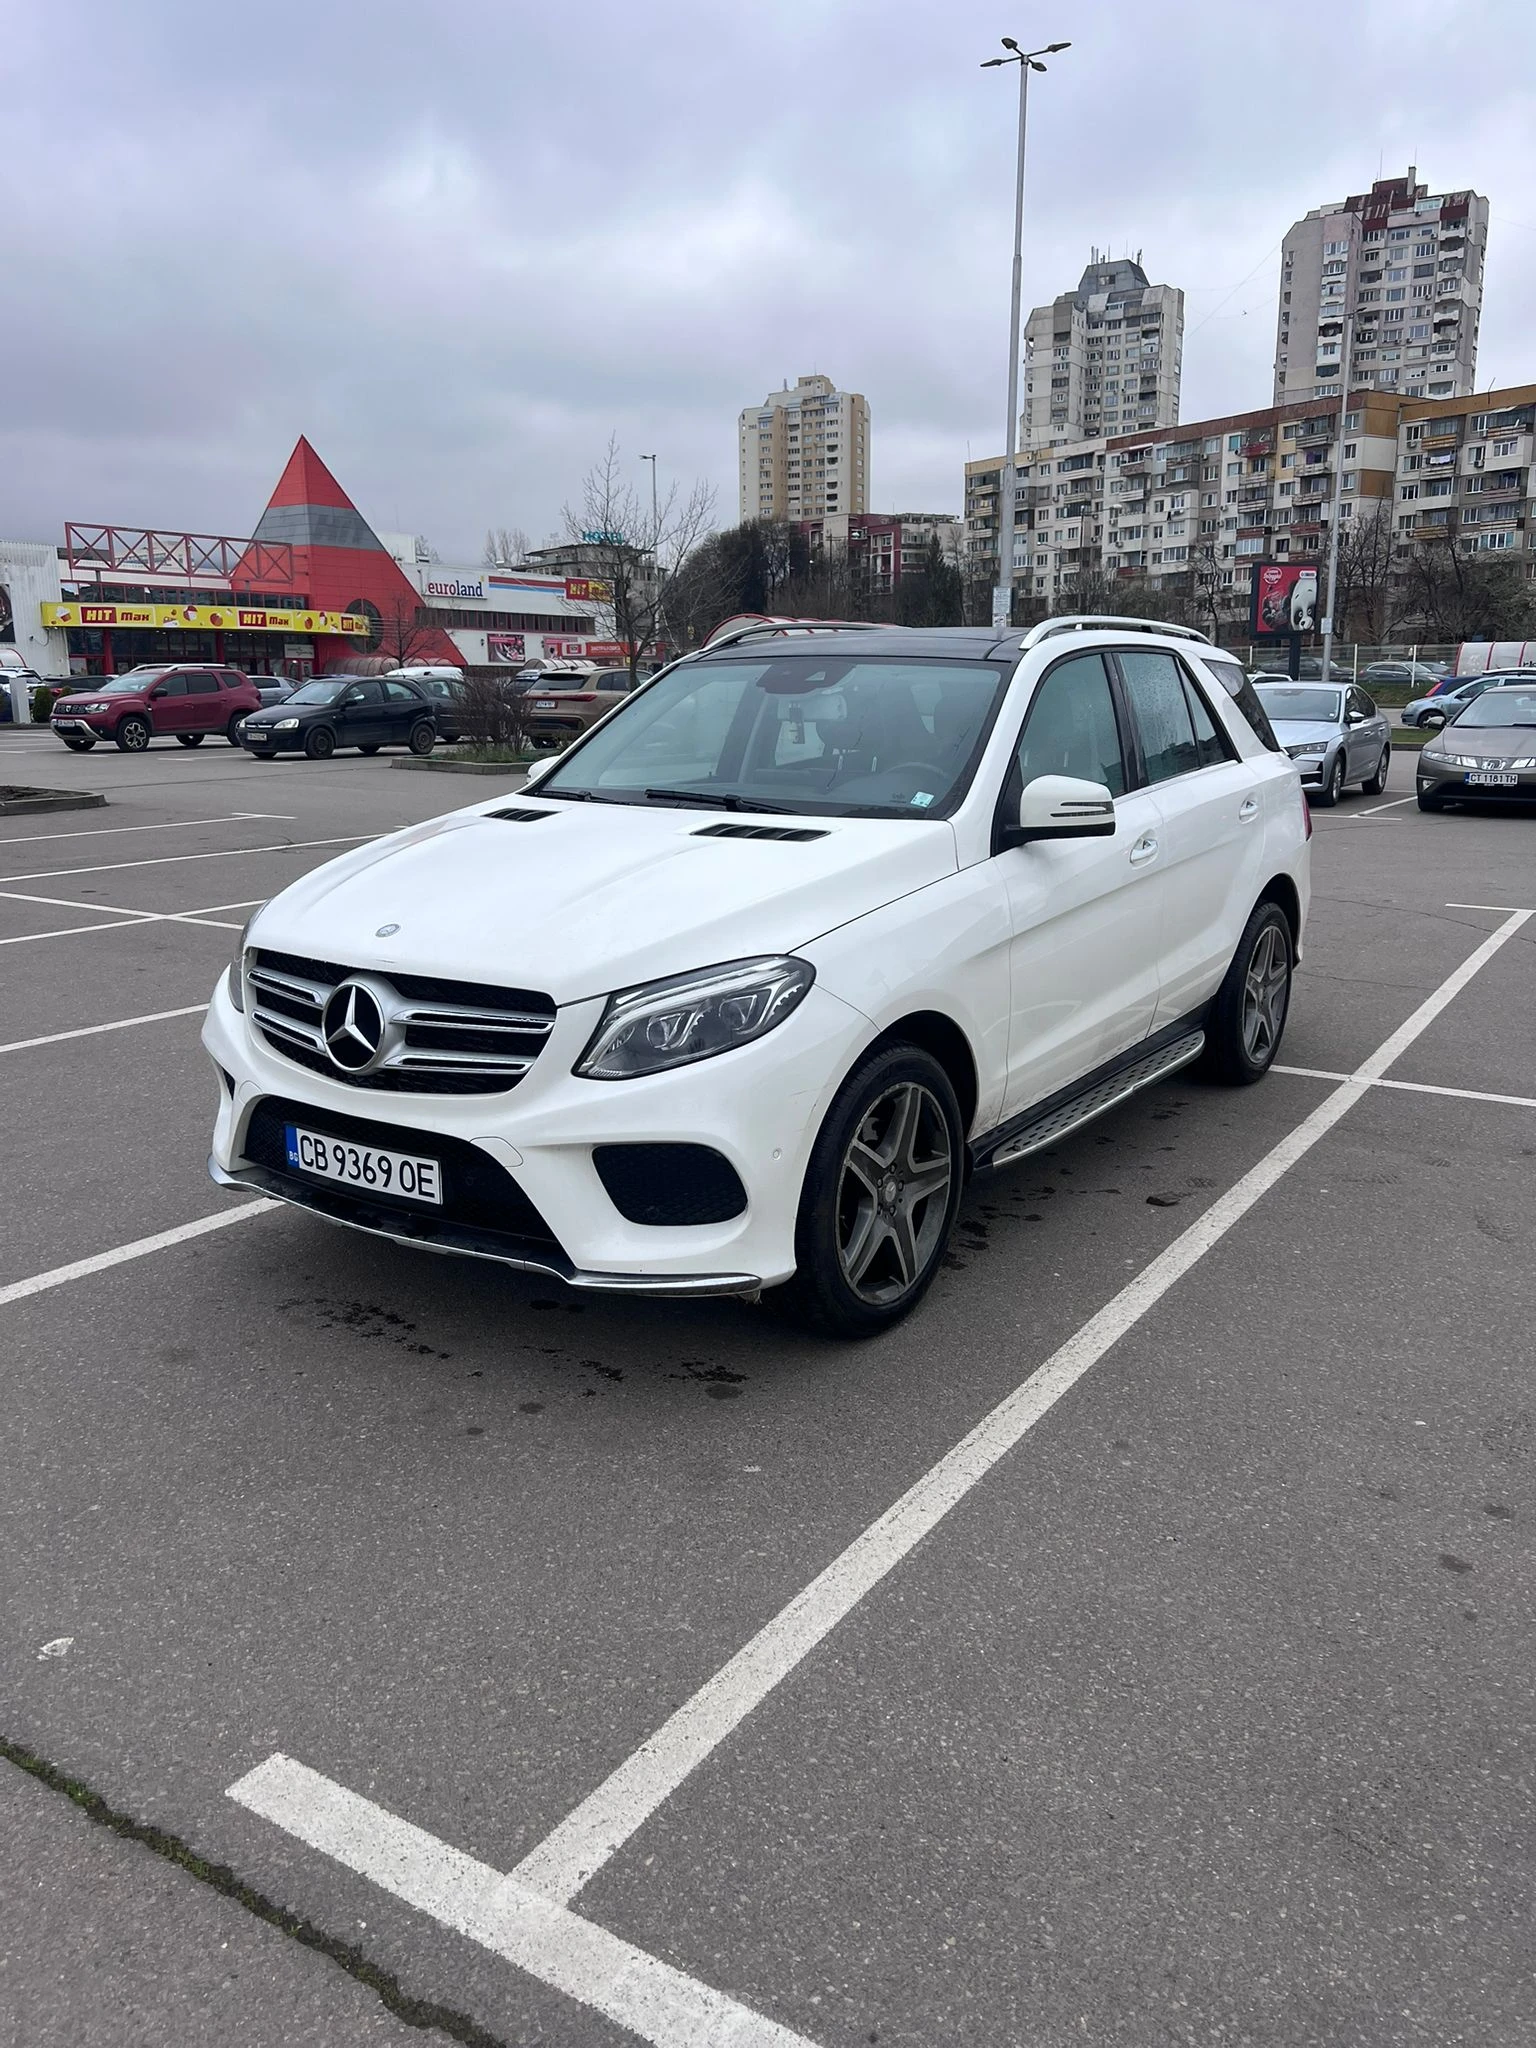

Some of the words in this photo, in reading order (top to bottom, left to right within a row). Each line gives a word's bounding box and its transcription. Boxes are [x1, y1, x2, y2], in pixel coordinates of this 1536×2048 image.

[428, 580, 483, 597] euroland
[570, 583, 587, 595] HIT
[86, 609, 113, 621] HIT
[243, 613, 264, 625] HIT
[1470, 773, 1481, 782] CT
[1484, 774, 1503, 783] 1181
[1505, 775, 1517, 783] TH
[289, 1151, 299, 1162] BG
[300, 1135, 328, 1171] CB
[333, 1144, 392, 1188] 9369
[399, 1160, 436, 1198] OE
